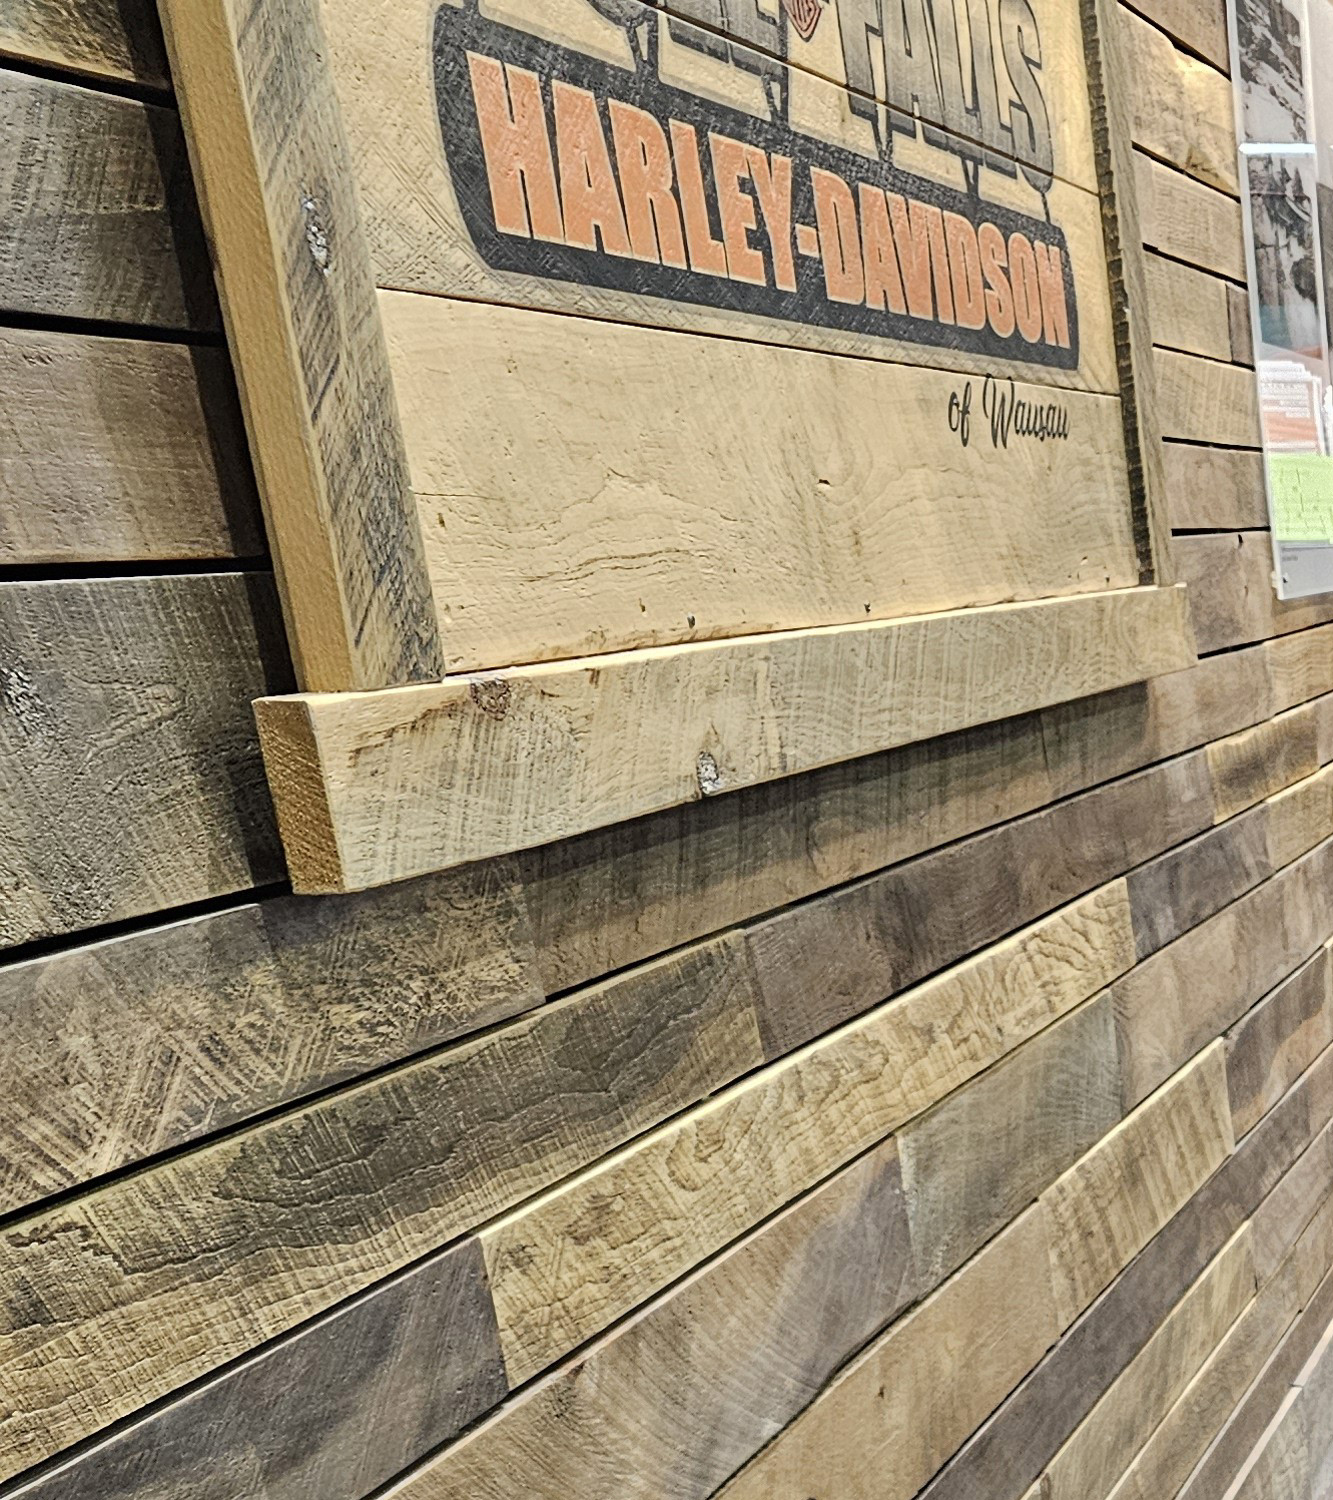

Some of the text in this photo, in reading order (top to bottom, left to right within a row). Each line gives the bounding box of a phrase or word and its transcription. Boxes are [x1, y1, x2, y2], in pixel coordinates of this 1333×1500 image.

[465, 50, 1071, 349] HARLEY-DAVIDSON
[948, 373, 1070, 449] of Wausau
